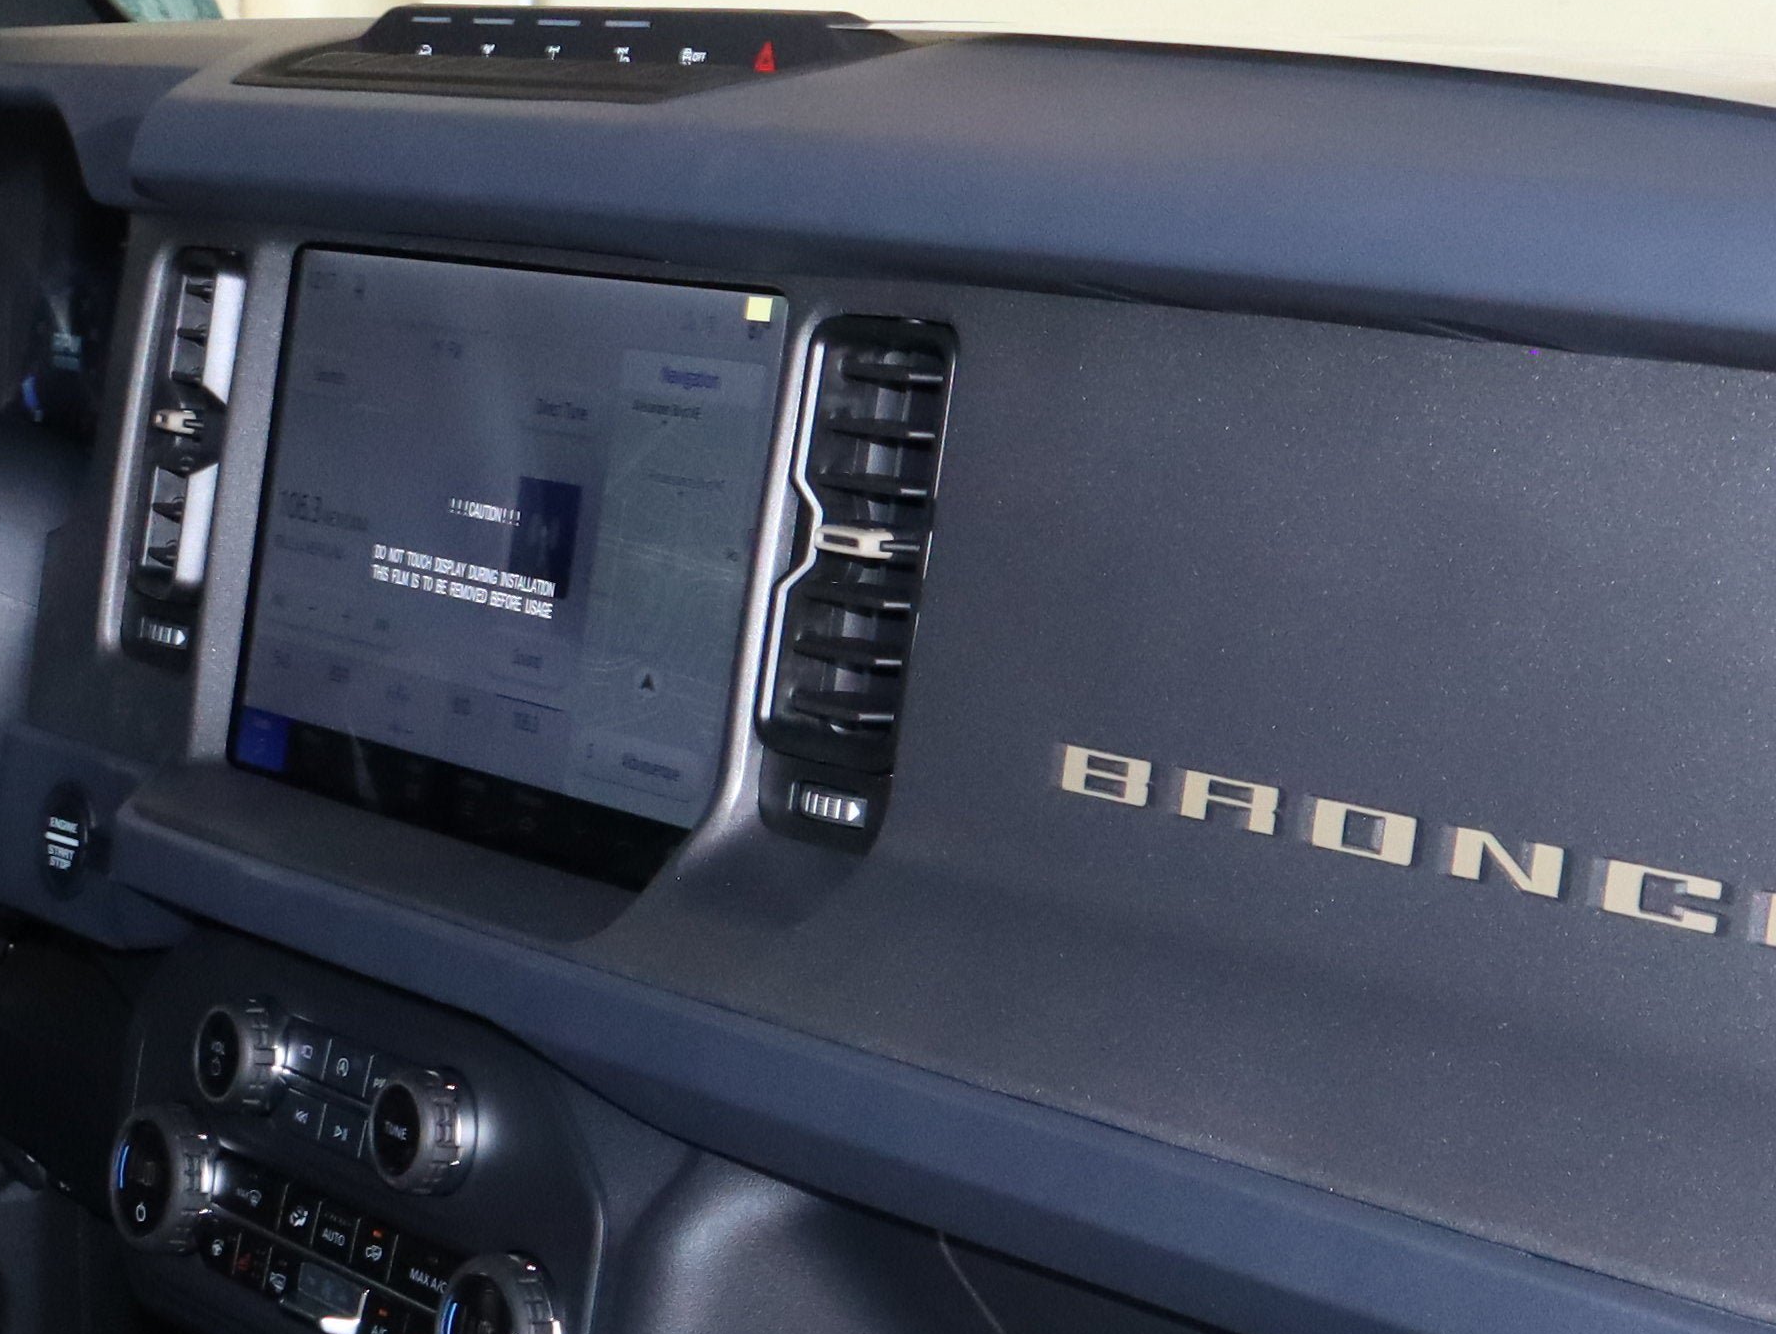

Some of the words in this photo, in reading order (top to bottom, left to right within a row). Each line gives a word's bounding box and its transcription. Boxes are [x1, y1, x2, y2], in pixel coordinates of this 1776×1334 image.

[374, 544, 386, 559] DO
[388, 547, 404, 563] NOT
[406, 551, 433, 571] TOUCH
[434, 557, 467, 577] DISPLAY
[468, 565, 498, 585] DURING
[500, 571, 556, 597] INSTALLATION
[371, 564, 389, 582] THIS
[391, 568, 410, 586] FILM
[411, 573, 420, 588] IS
[422, 575, 433, 591] TO
[435, 578, 448, 595] BE
[449, 581, 487, 603] REMOVED
[489, 591, 522, 611] BEFORE
[524, 598, 553, 619] USAGE
[50, 817, 78, 833] ENGINE
[48, 844, 75, 860] START
[49, 855, 71, 869] STOP
[384, 1120, 408, 1142] TUNE
[322, 1227, 346, 1247] AUTO
[409, 1268, 430, 1288] MAX
[430, 1277, 448, 1294] A/C
